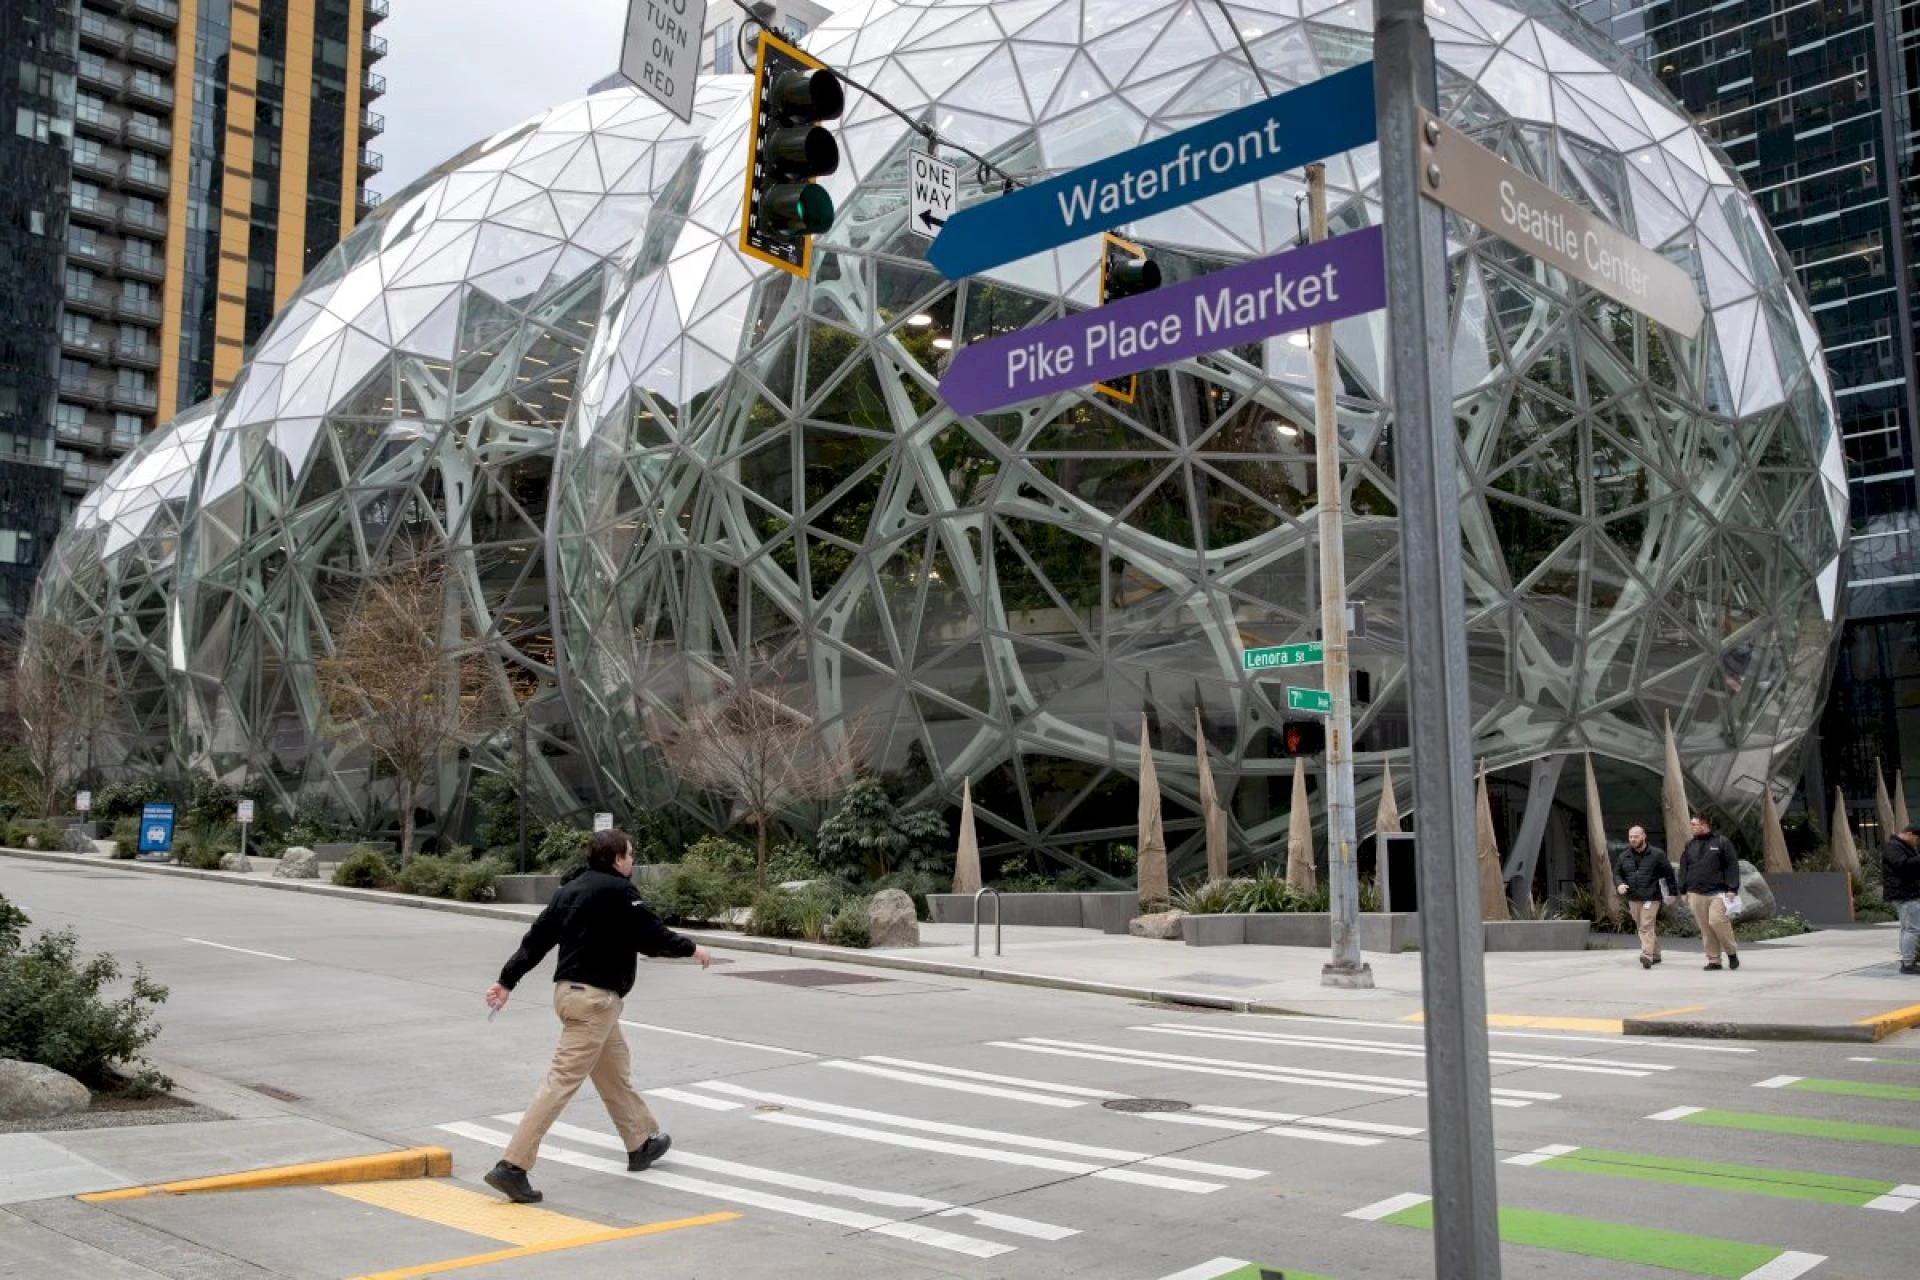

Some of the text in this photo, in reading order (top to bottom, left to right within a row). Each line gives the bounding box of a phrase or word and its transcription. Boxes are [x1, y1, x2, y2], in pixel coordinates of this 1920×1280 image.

[648, 1, 687, 48] TURN
[653, 38, 674, 68] ON
[643, 61, 675, 97] RED
[916, 159, 951, 189] ONE
[1058, 116, 1281, 226] Waterfront
[915, 181, 951, 211] WAY
[1500, 180, 1649, 296] Seattle Center
[1007, 263, 1339, 388] Pike Place Market
[1247, 651, 1288, 667] Lenora
